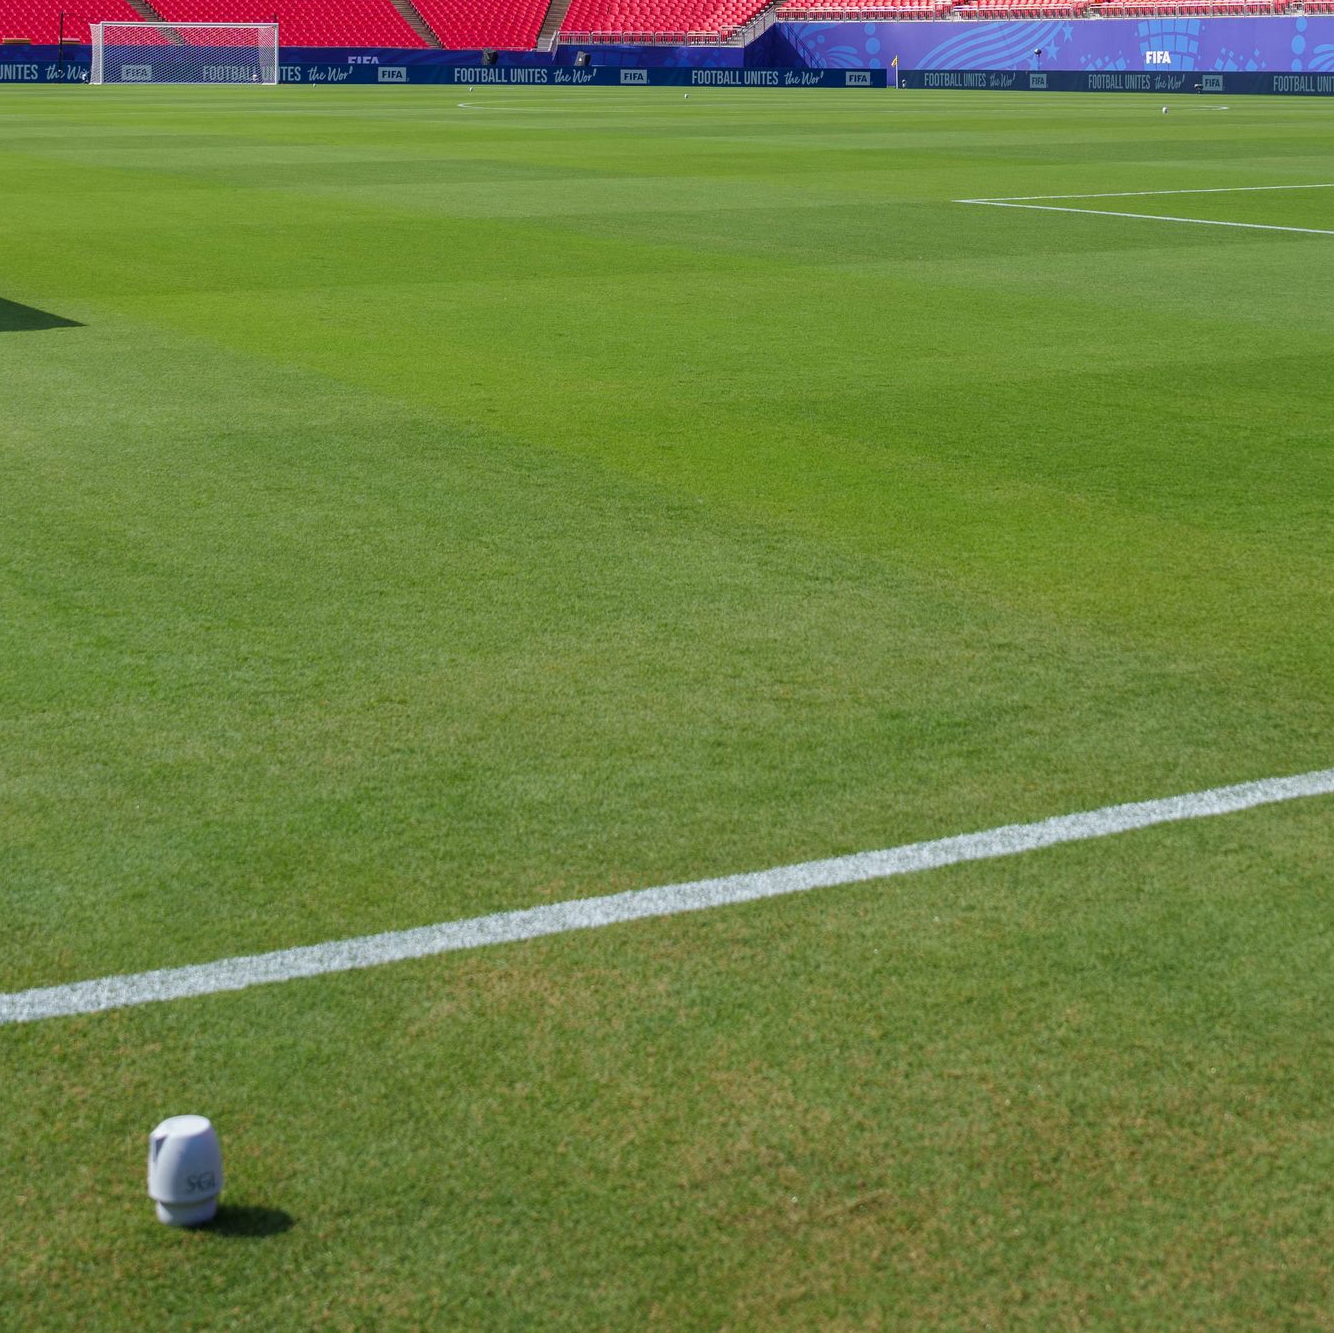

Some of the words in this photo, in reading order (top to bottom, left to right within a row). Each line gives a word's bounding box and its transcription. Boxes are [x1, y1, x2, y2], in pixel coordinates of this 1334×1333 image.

[1145, 50, 1171, 64] FIFA
[124, 68, 149, 78] FIFA
[307, 66, 327, 81] the
[381, 70, 404, 79] FIFA
[454, 68, 508, 83] FOOTBALL
[510, 68, 548, 83] UNITES
[553, 68, 571, 83] the
[624, 72, 645, 82] FIFA
[691, 69, 742, 85] FOOTBALL
[744, 70, 779, 85] UNITES
[783, 70, 801, 85] the
[848, 74, 868, 83] FIFA
[924, 72, 963, 87] FOOTBALL
[963, 72, 987, 87] UNITES
[989, 72, 1000, 87] the
[1031, 75, 1045, 85] FIFA
[1088, 74, 1124, 89] FOOTBALL
[1124, 74, 1151, 90] UNITES
[1153, 73, 1167, 90] the
[1204, 77, 1221, 88] FIFA
[1273, 75, 1316, 92] FOOTBALL
